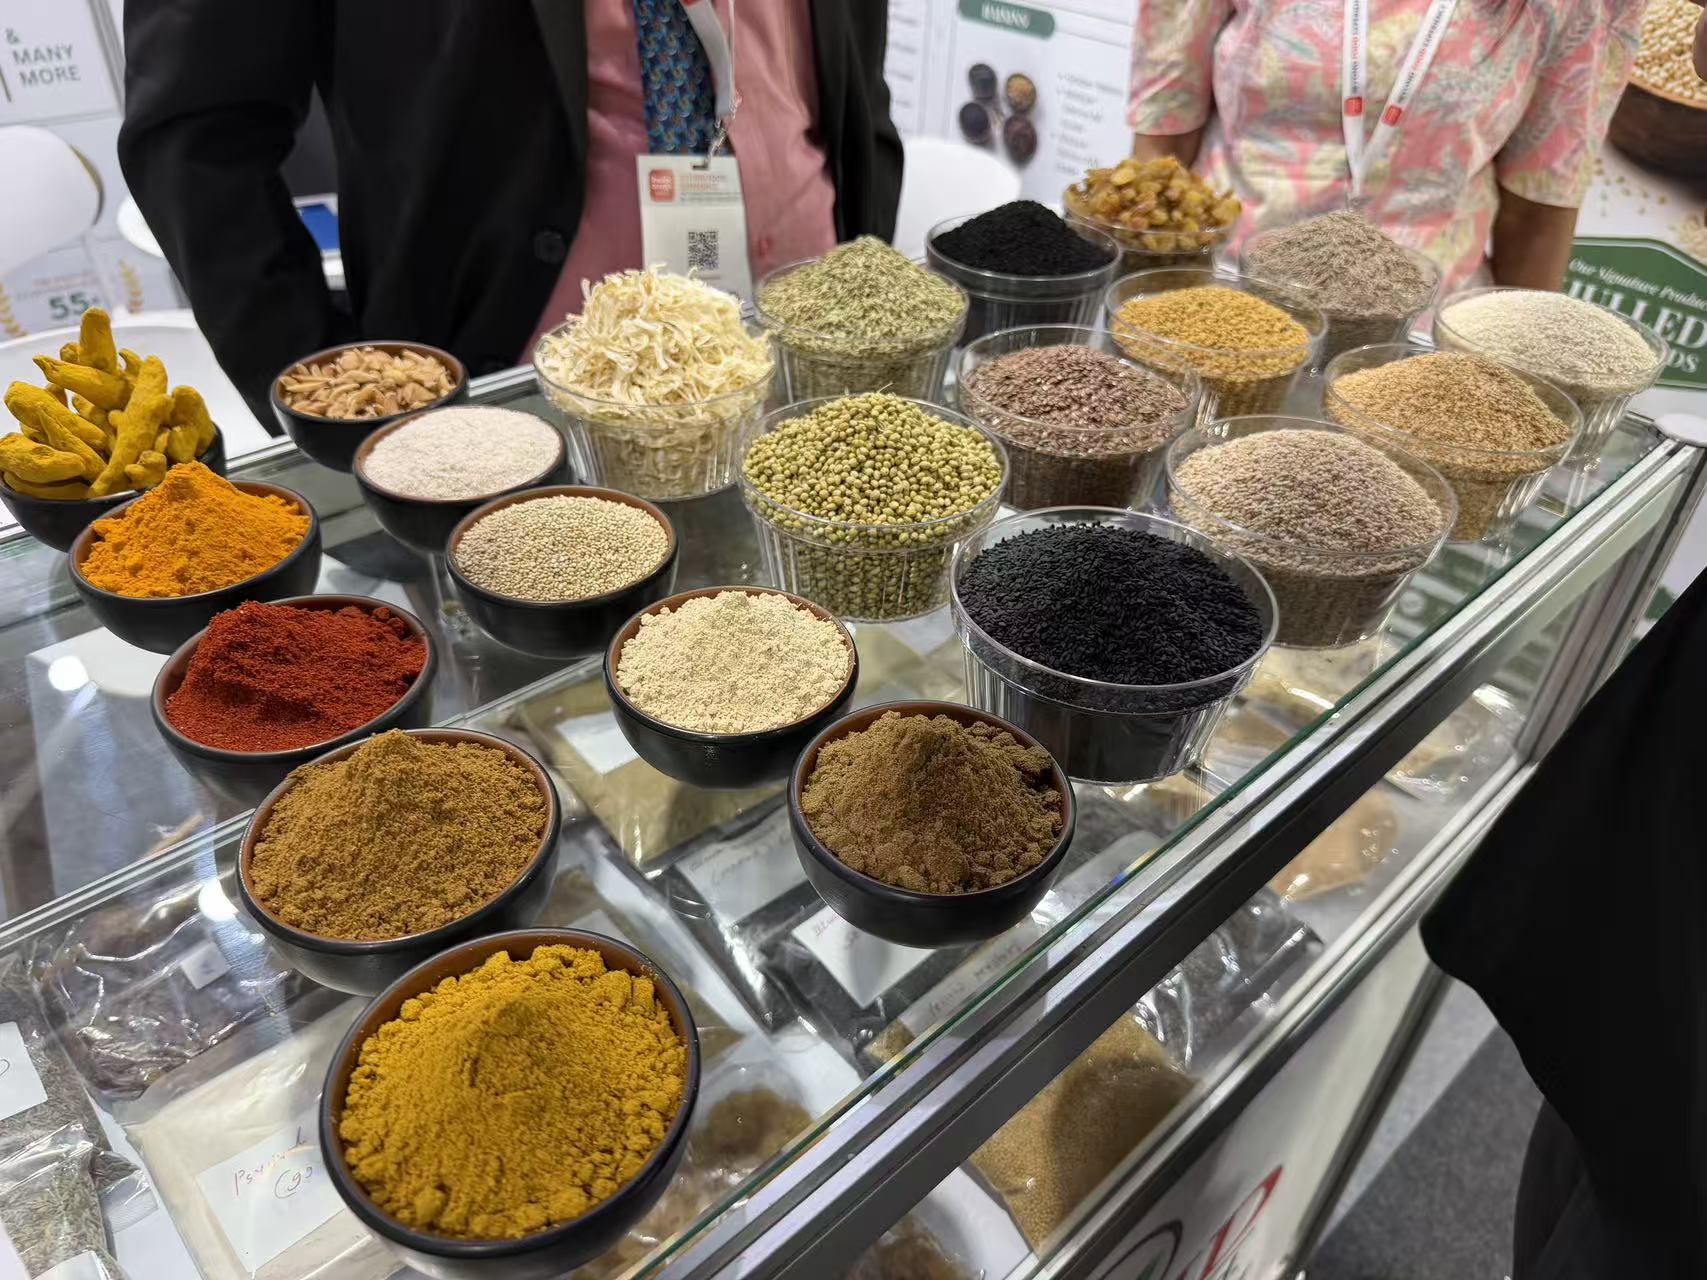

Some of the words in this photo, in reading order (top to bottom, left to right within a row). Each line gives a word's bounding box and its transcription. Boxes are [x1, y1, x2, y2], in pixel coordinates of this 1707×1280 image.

[5, 28, 20, 45] &
[13, 45, 73, 65] MANY
[20, 66, 81, 88] MORE
